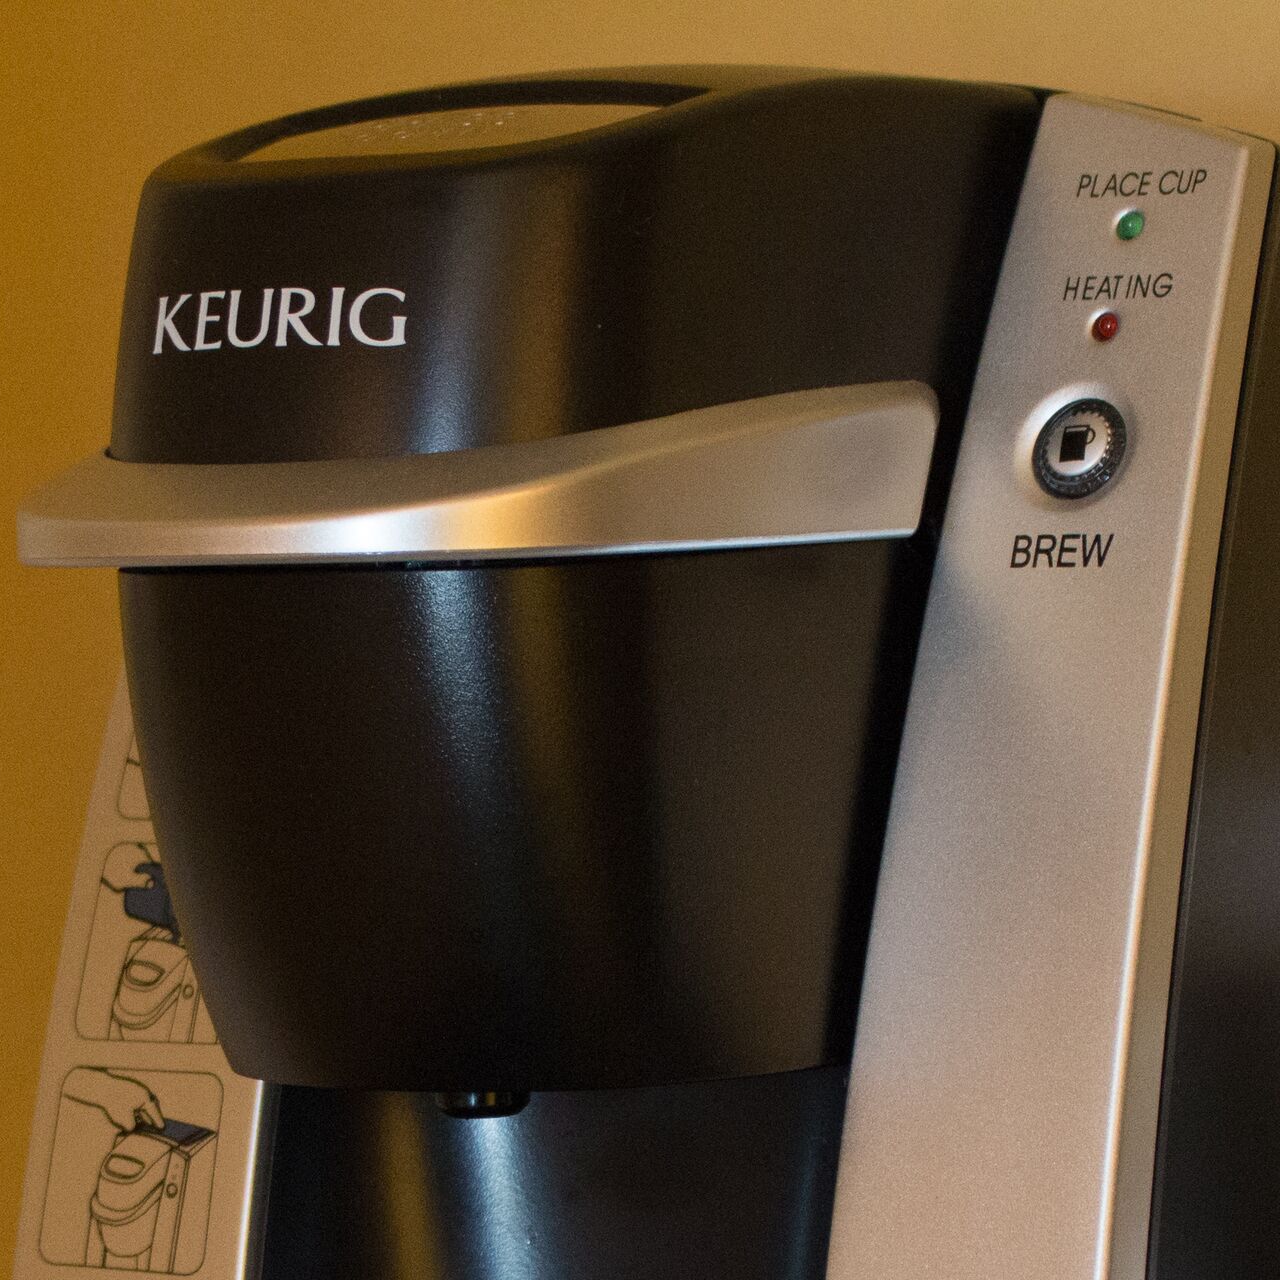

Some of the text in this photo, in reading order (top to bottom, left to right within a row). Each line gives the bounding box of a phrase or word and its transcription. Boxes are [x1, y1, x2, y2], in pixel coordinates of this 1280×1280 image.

[1076, 168, 1208, 199] PLACE CUP
[1062, 272, 1174, 302] HEATING
[152, 286, 408, 355] KEURIG
[1009, 533, 1114, 570] BREW
